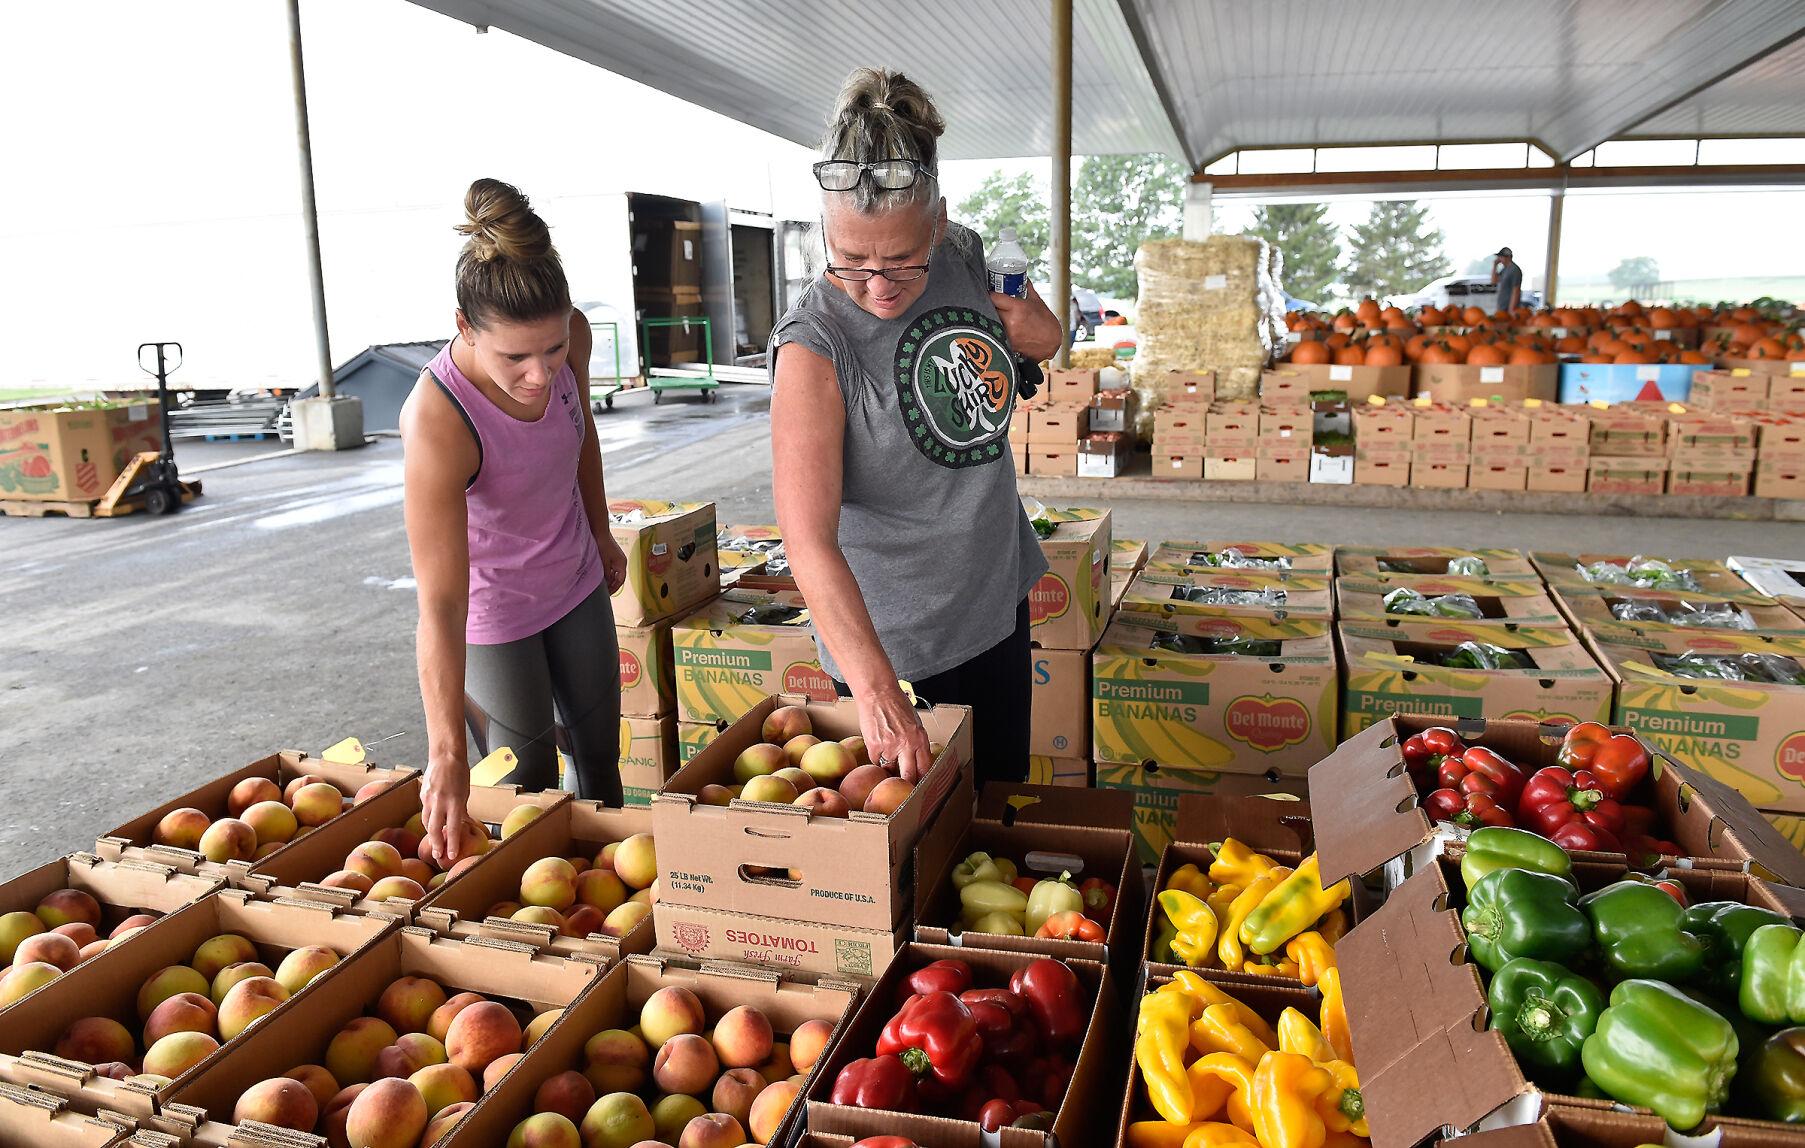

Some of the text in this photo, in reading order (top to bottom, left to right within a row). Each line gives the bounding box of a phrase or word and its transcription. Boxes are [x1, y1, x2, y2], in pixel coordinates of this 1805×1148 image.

[934, 340, 989, 394] LUCKY
[950, 376, 1004, 427] SHIRT
[1029, 588, 1065, 603] onte
[682, 649, 751, 667] Premium
[620, 661, 637, 674] nte
[684, 669, 764, 687] BANANAS
[788, 675, 835, 691] Del Mon
[1099, 681, 1183, 700] Premium
[1099, 702, 1197, 722] BANANAS
[1360, 694, 1453, 715] Premium
[1231, 711, 1305, 729] Del Monte
[1624, 711, 1726, 735] Premium
[1656, 737, 1741, 760] NANAS
[1783, 747, 1805, 764] De
[670, 871, 679, 880] 25
[680, 872, 689, 881] LB
[690, 873, 701, 882] Net
[810, 888, 876, 904] PRODUCE OF U.S.A.
[725, 929, 819, 954] TOMATOES
[743, 949, 803, 967] Farm Fresh
